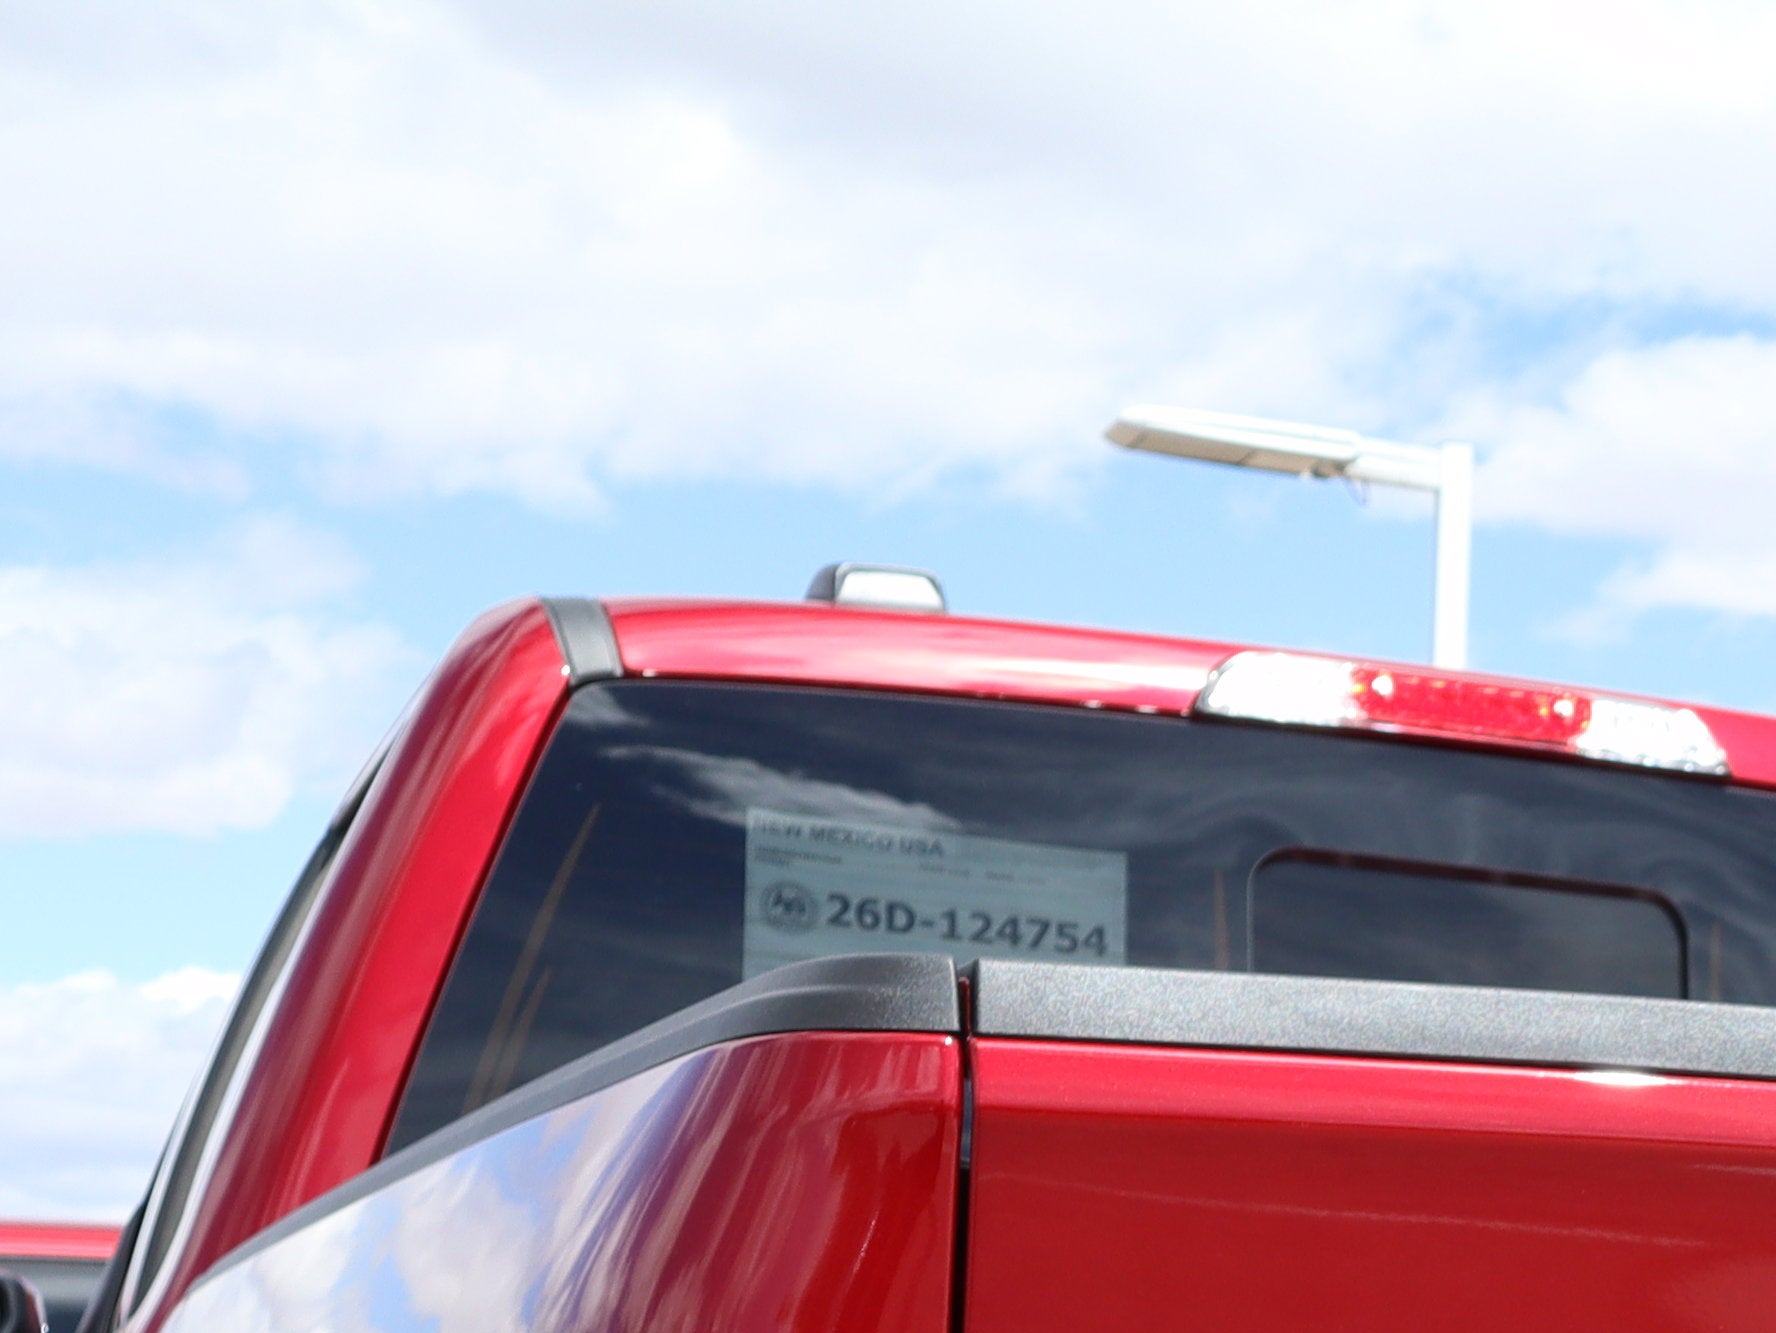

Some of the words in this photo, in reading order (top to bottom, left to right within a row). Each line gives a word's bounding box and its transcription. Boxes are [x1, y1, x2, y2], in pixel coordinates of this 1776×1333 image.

[808, 824, 892, 851] MEXICO
[898, 836, 945, 858] USA
[825, 892, 1107, 957] 26D-124754
